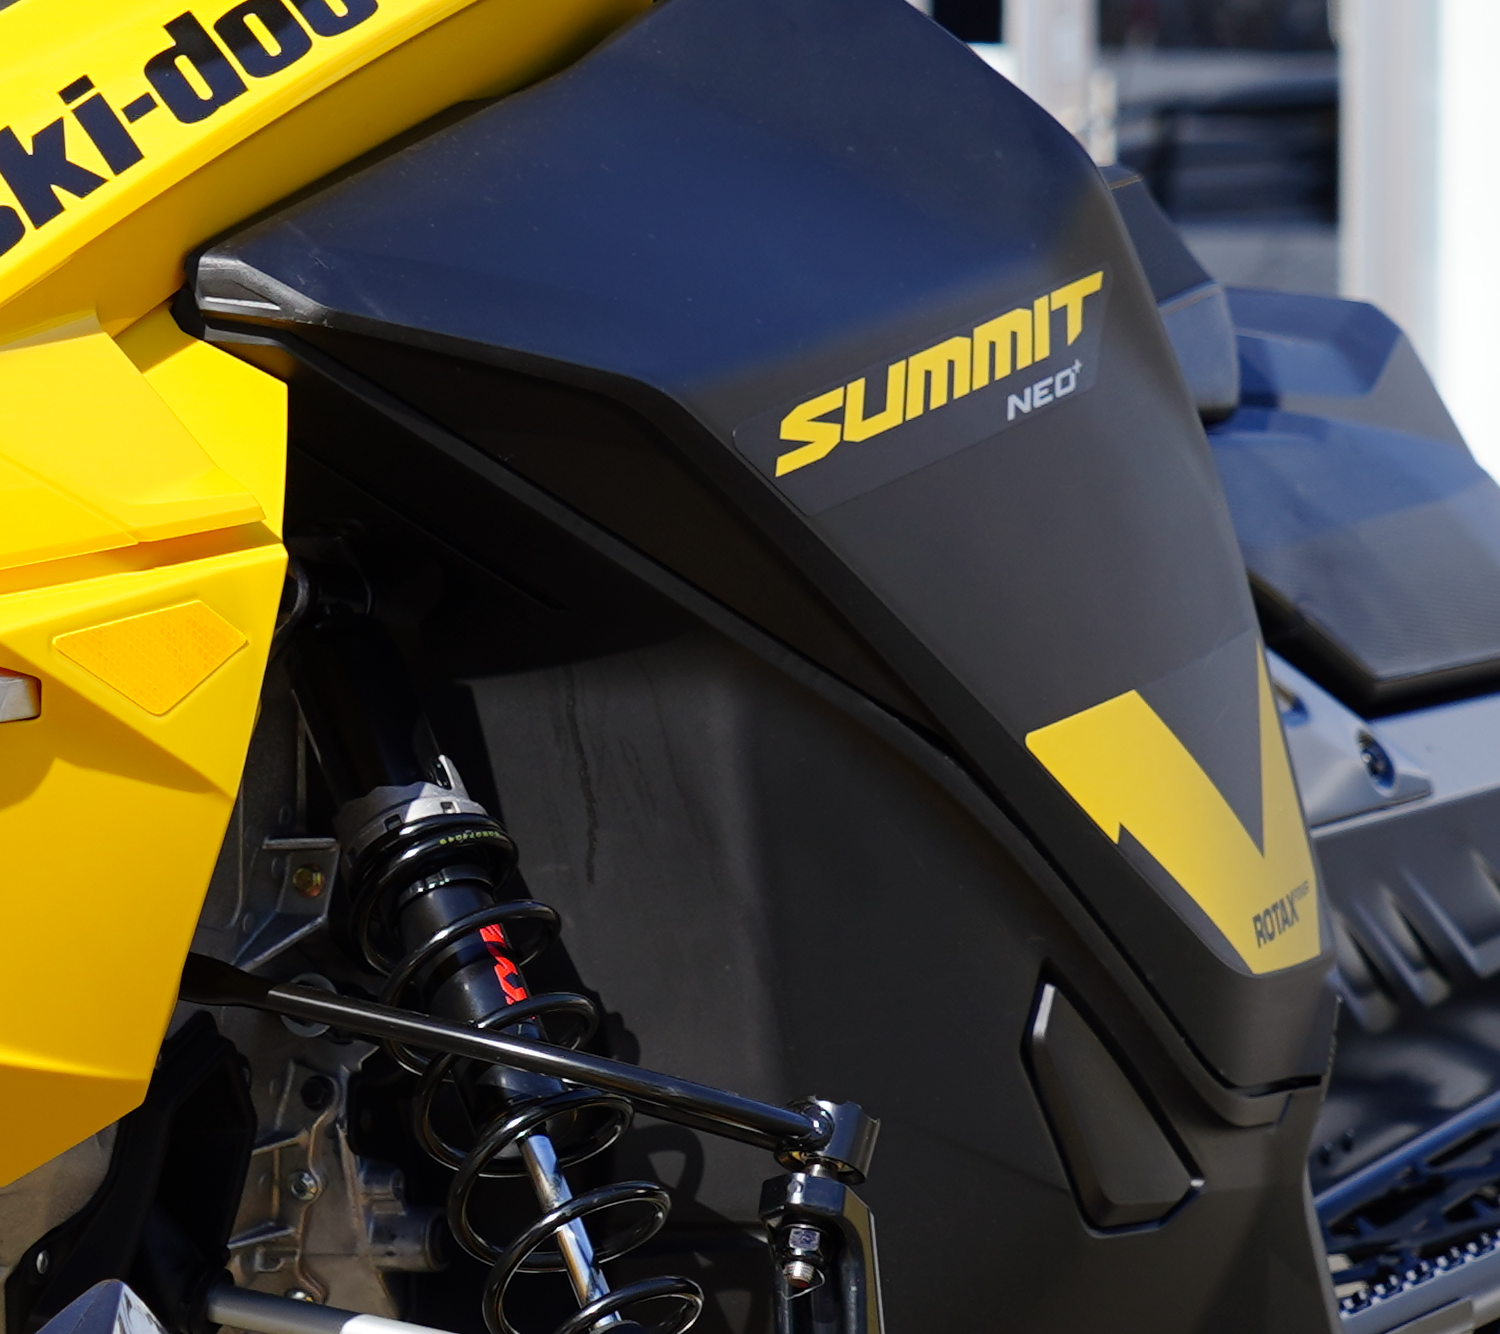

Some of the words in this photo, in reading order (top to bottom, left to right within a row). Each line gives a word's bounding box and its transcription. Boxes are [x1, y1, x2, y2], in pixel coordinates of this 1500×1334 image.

[775, 271, 1103, 477] SUMMIT
[1007, 359, 1083, 422] NEO+
[1252, 893, 1299, 949] ROTAX
